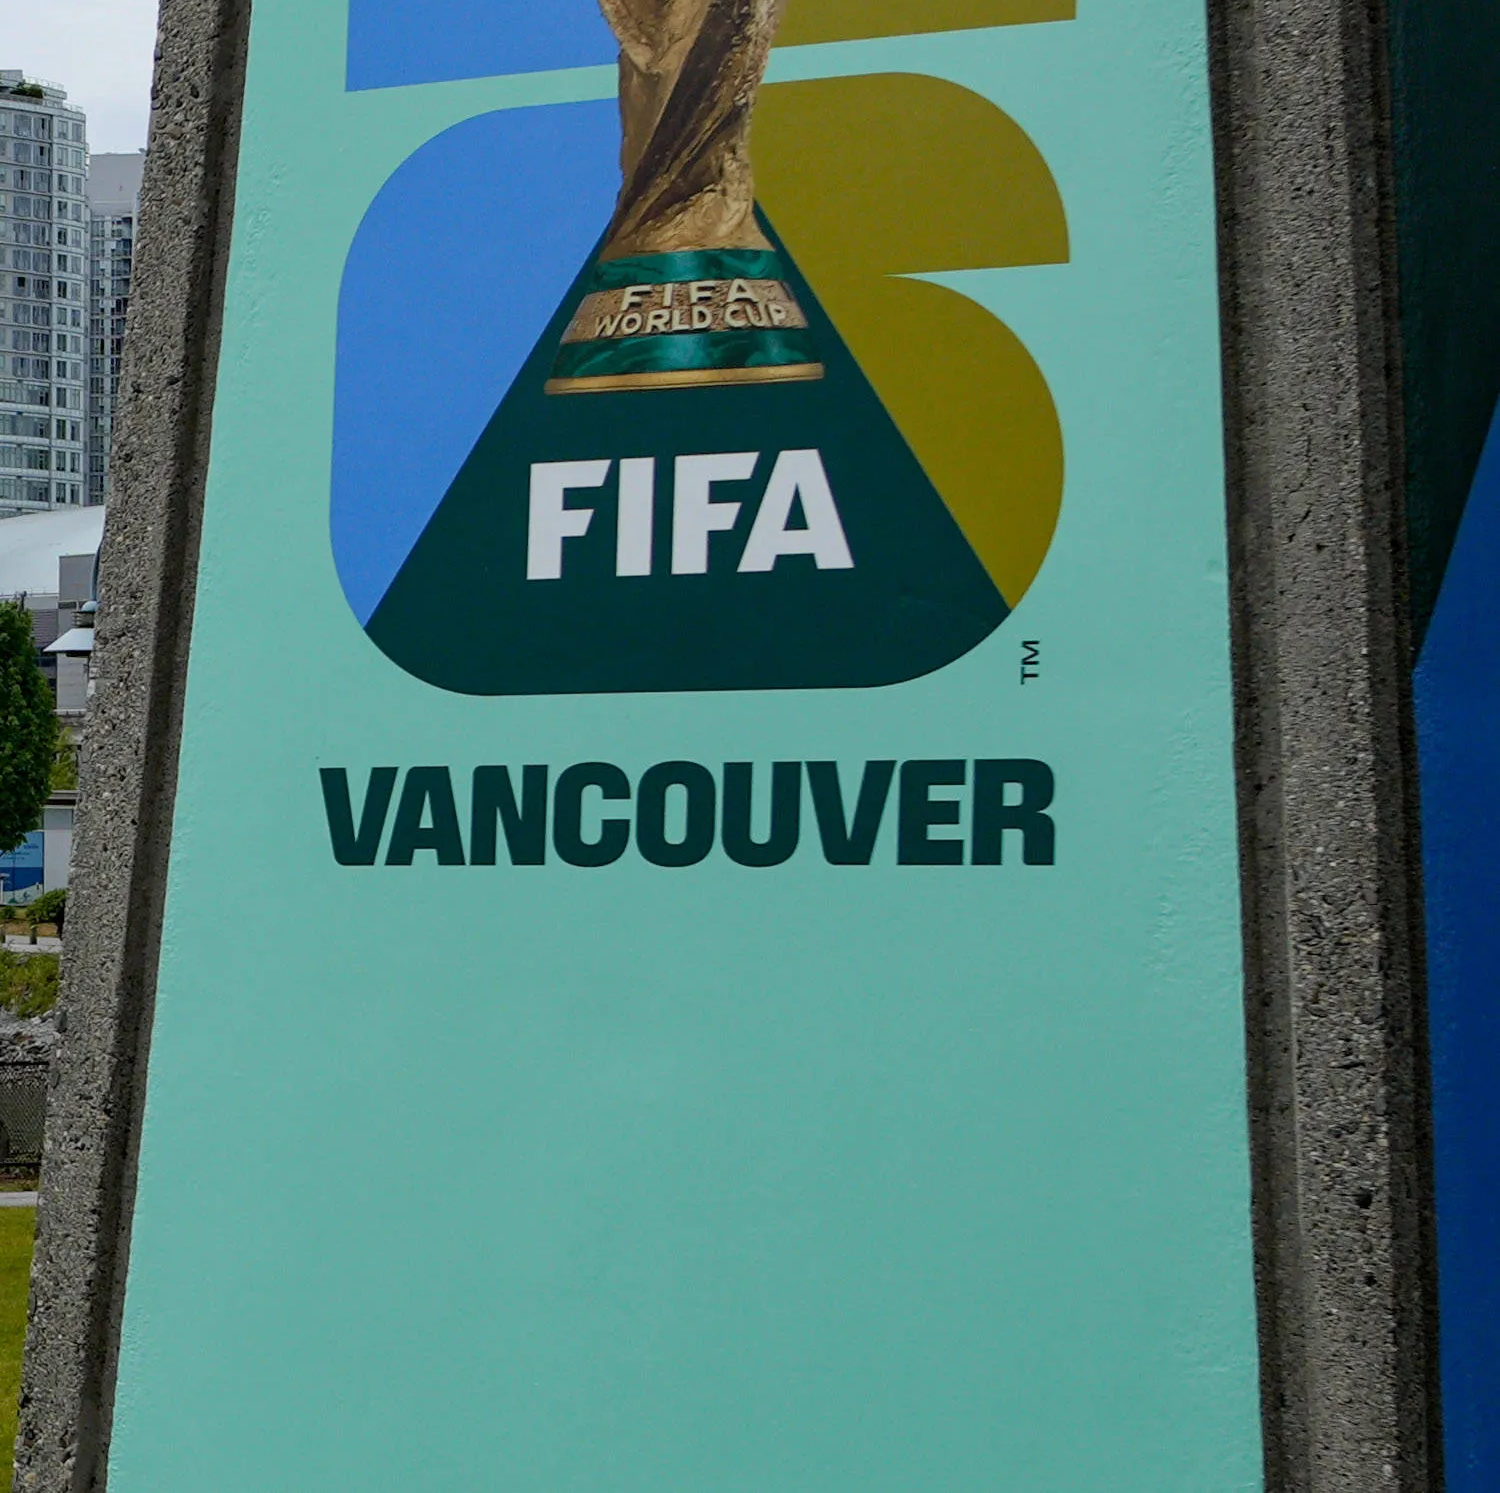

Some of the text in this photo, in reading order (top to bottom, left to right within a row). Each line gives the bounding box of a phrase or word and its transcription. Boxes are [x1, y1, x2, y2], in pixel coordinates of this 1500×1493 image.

[594, 302, 789, 338] WORLD CUP
[621, 278, 760, 312] FIFA
[526, 448, 855, 582] FIFA
[318, 758, 1056, 868] VANCOUVER
